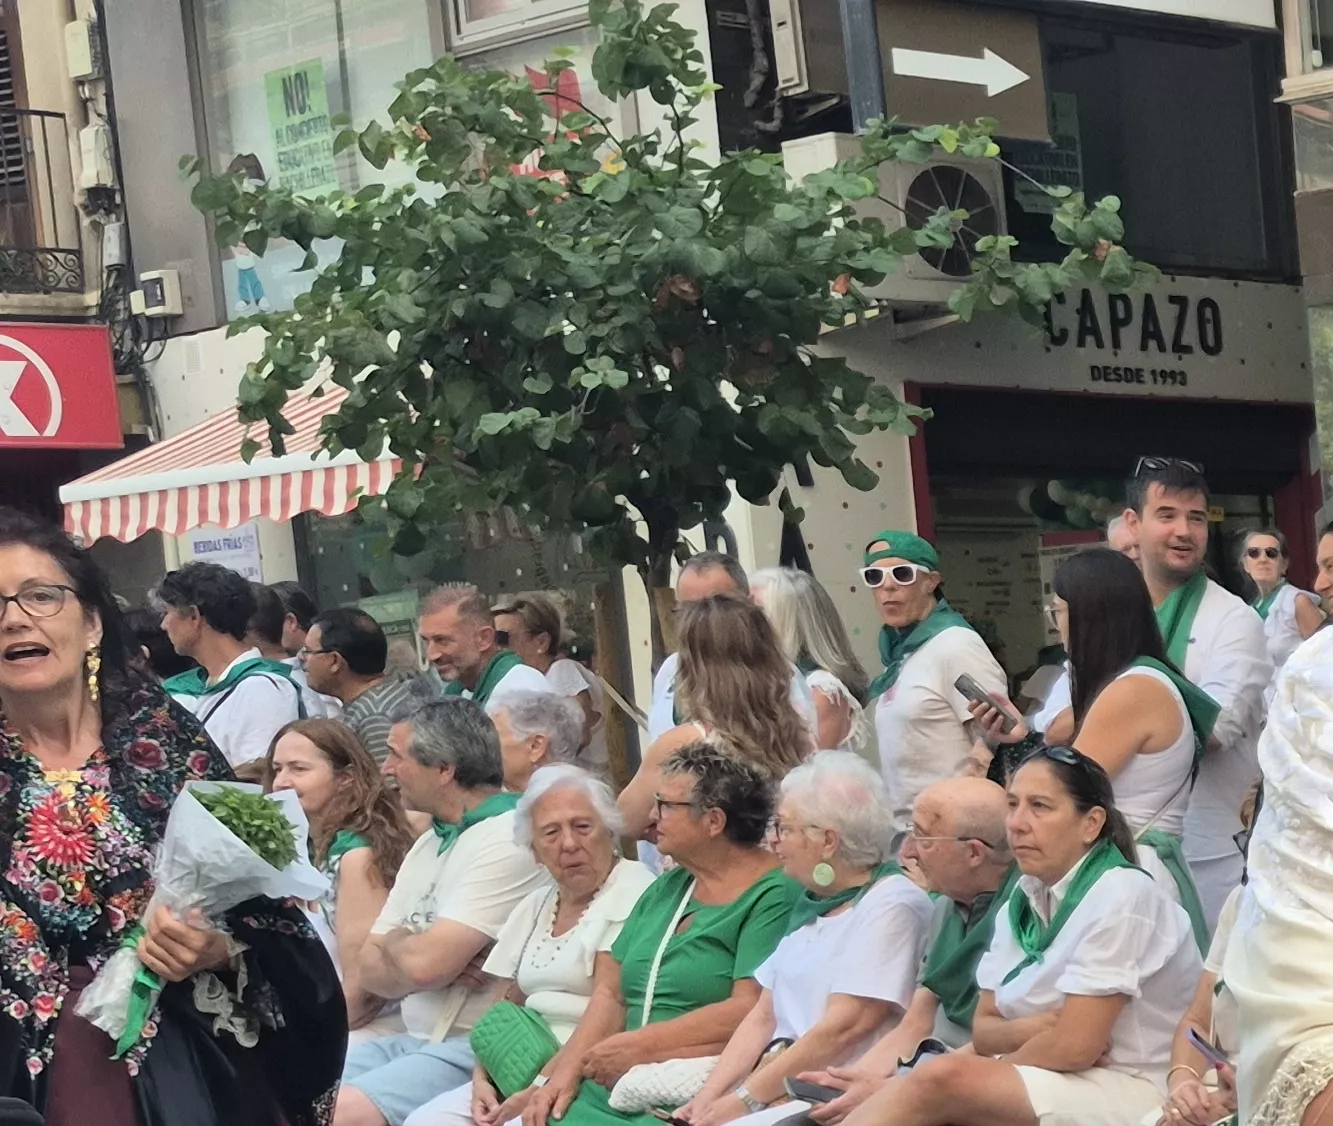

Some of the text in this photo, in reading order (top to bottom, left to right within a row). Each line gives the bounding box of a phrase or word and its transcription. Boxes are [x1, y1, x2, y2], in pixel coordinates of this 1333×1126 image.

[282, 70, 311, 118] NO!
[1045, 288, 1223, 356] CAPAZO
[1090, 365, 1187, 386] DESDE 1993
